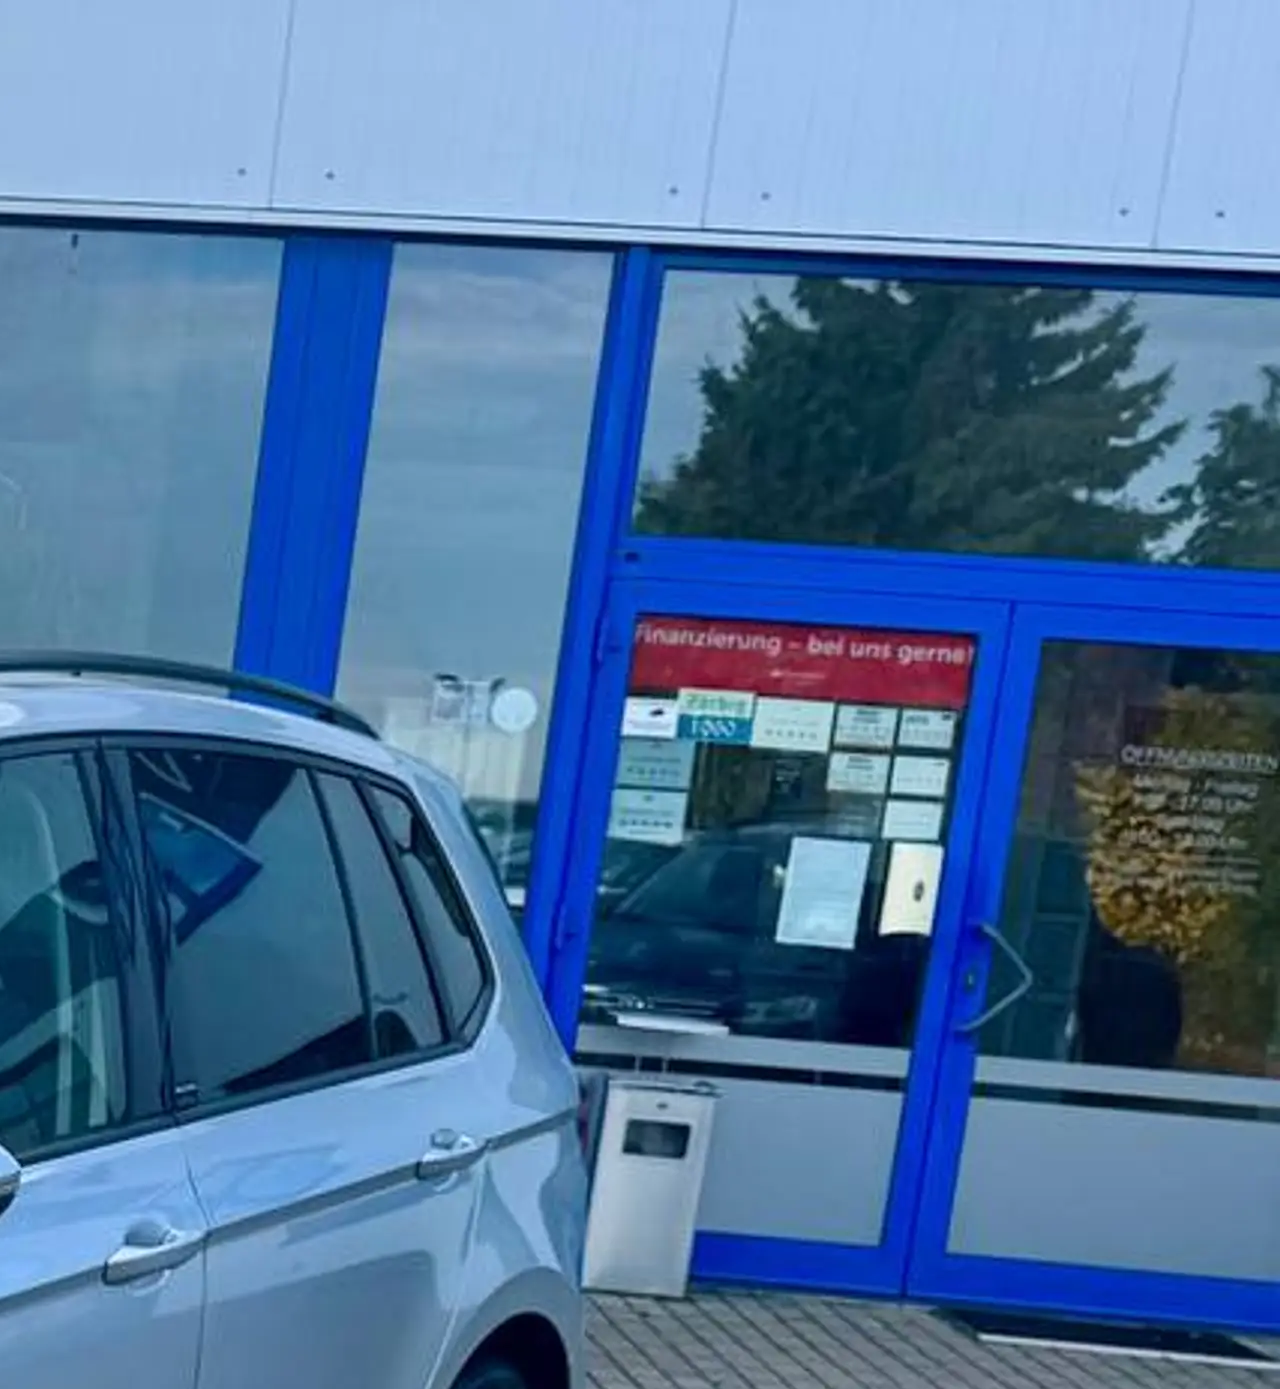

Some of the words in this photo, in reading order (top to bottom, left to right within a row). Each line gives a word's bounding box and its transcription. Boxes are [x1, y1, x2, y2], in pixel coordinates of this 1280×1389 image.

[635, 623, 781, 657] Finanzierung
[807, 636, 844, 657] bei
[850, 642, 893, 659] uns
